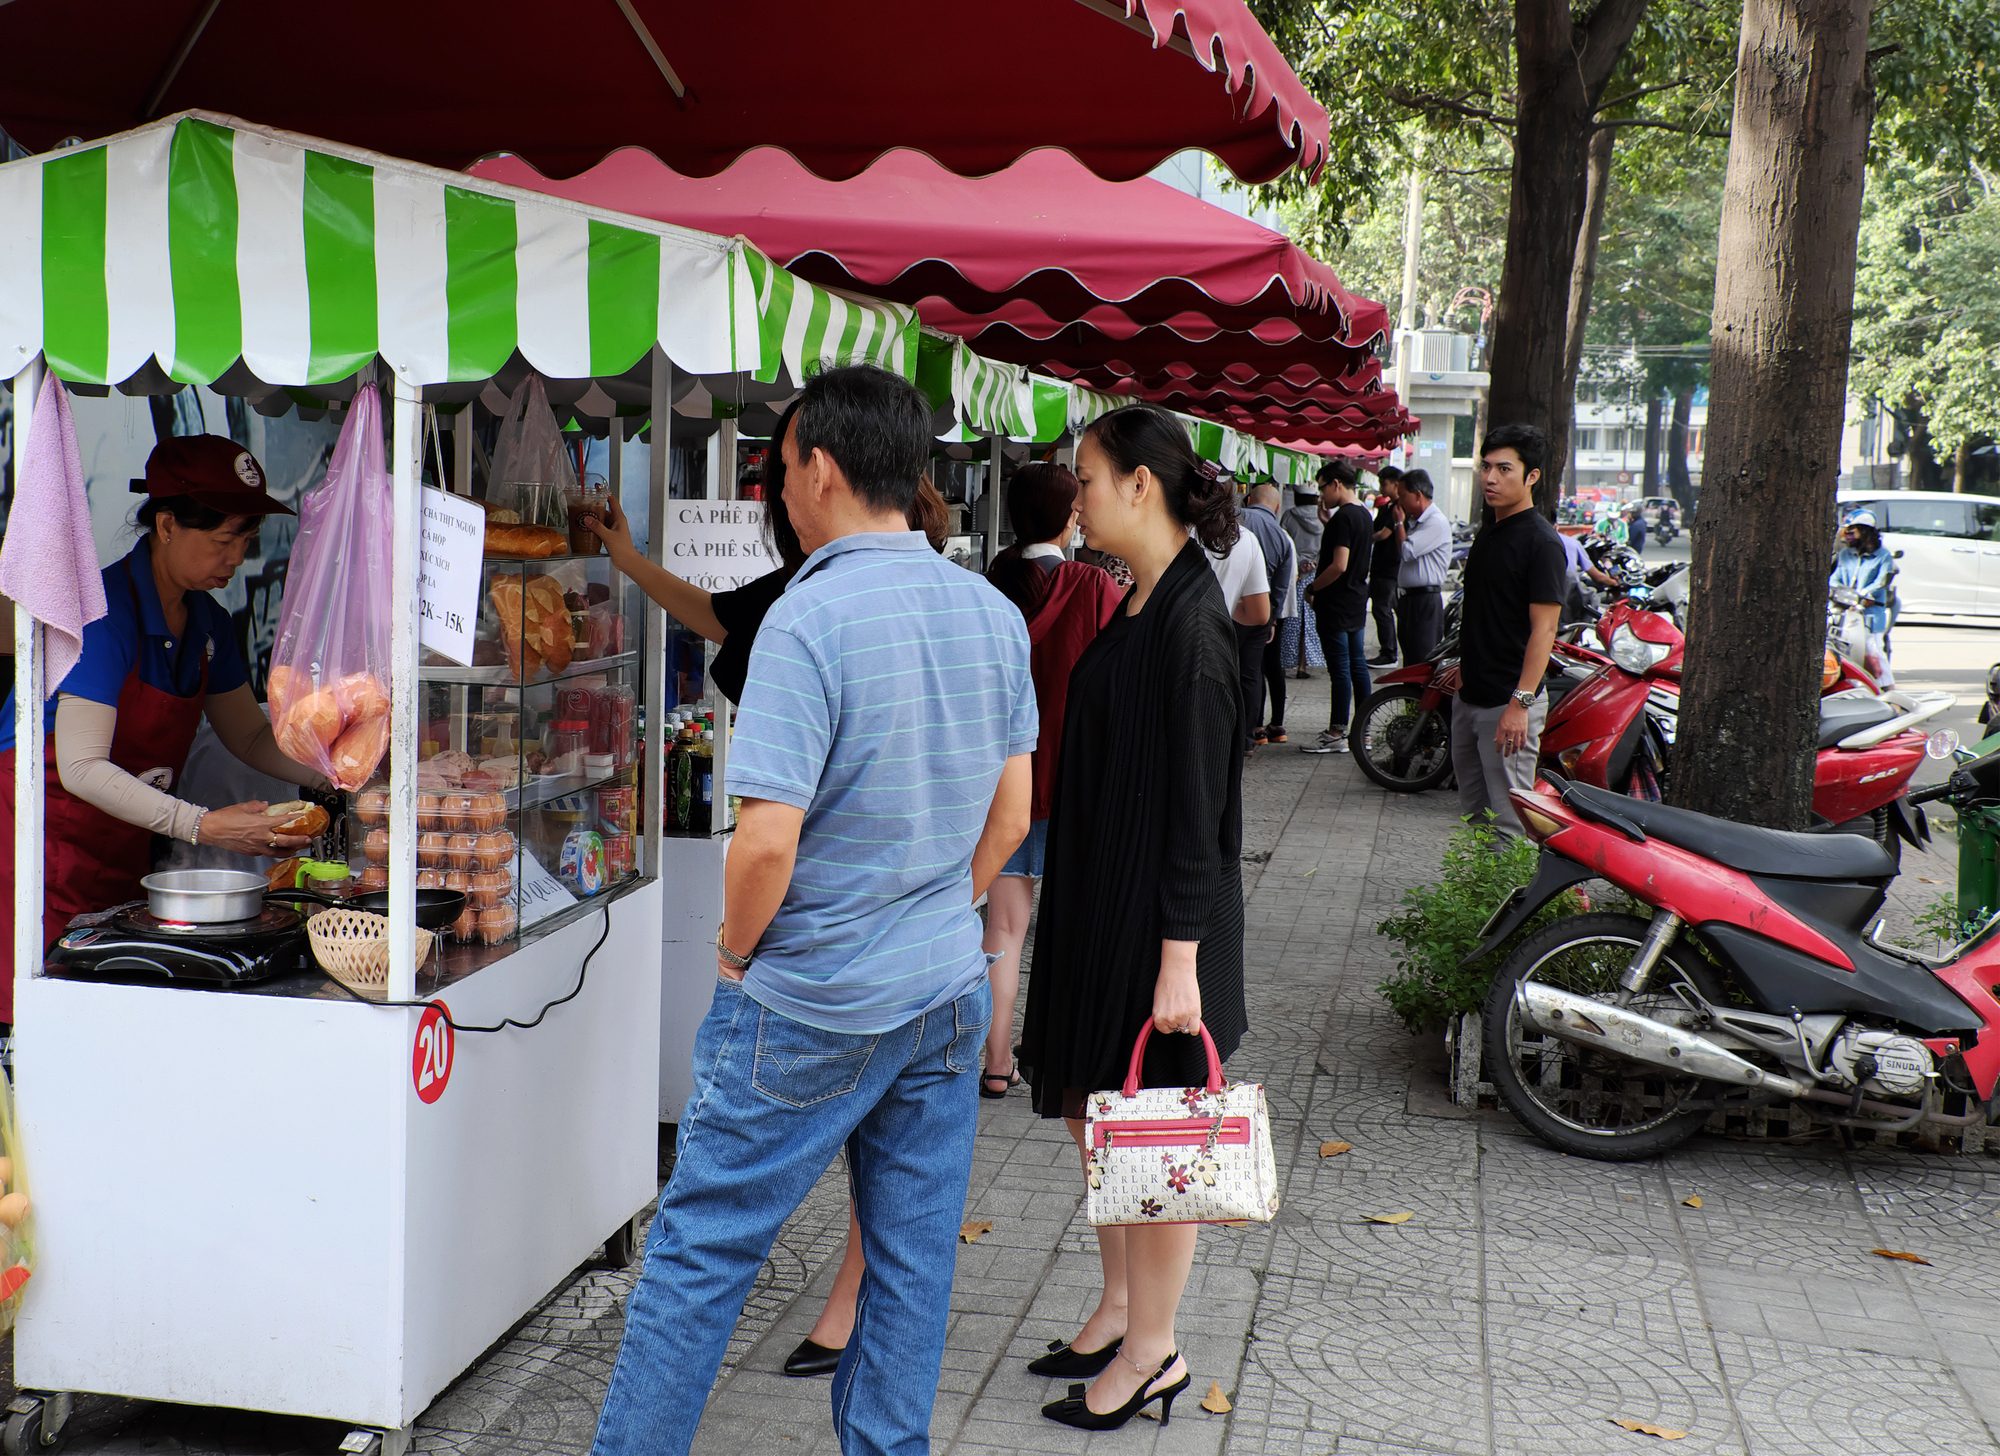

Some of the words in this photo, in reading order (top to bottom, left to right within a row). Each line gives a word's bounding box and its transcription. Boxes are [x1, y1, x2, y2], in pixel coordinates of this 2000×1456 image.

[679, 506, 704, 524] CÀ
[710, 506, 742, 524] PHÊ
[674, 539, 698, 557] CÀ
[704, 539, 737, 557] PHÊ
[681, 571, 725, 590] ƯỚC
[729, 575, 761, 590] NG
[445, 611, 465, 634] 15K
[527, 876, 562, 901] QUAY
[418, 1016, 448, 1093] 20
[1886, 1060, 1921, 1072] SINUDA
